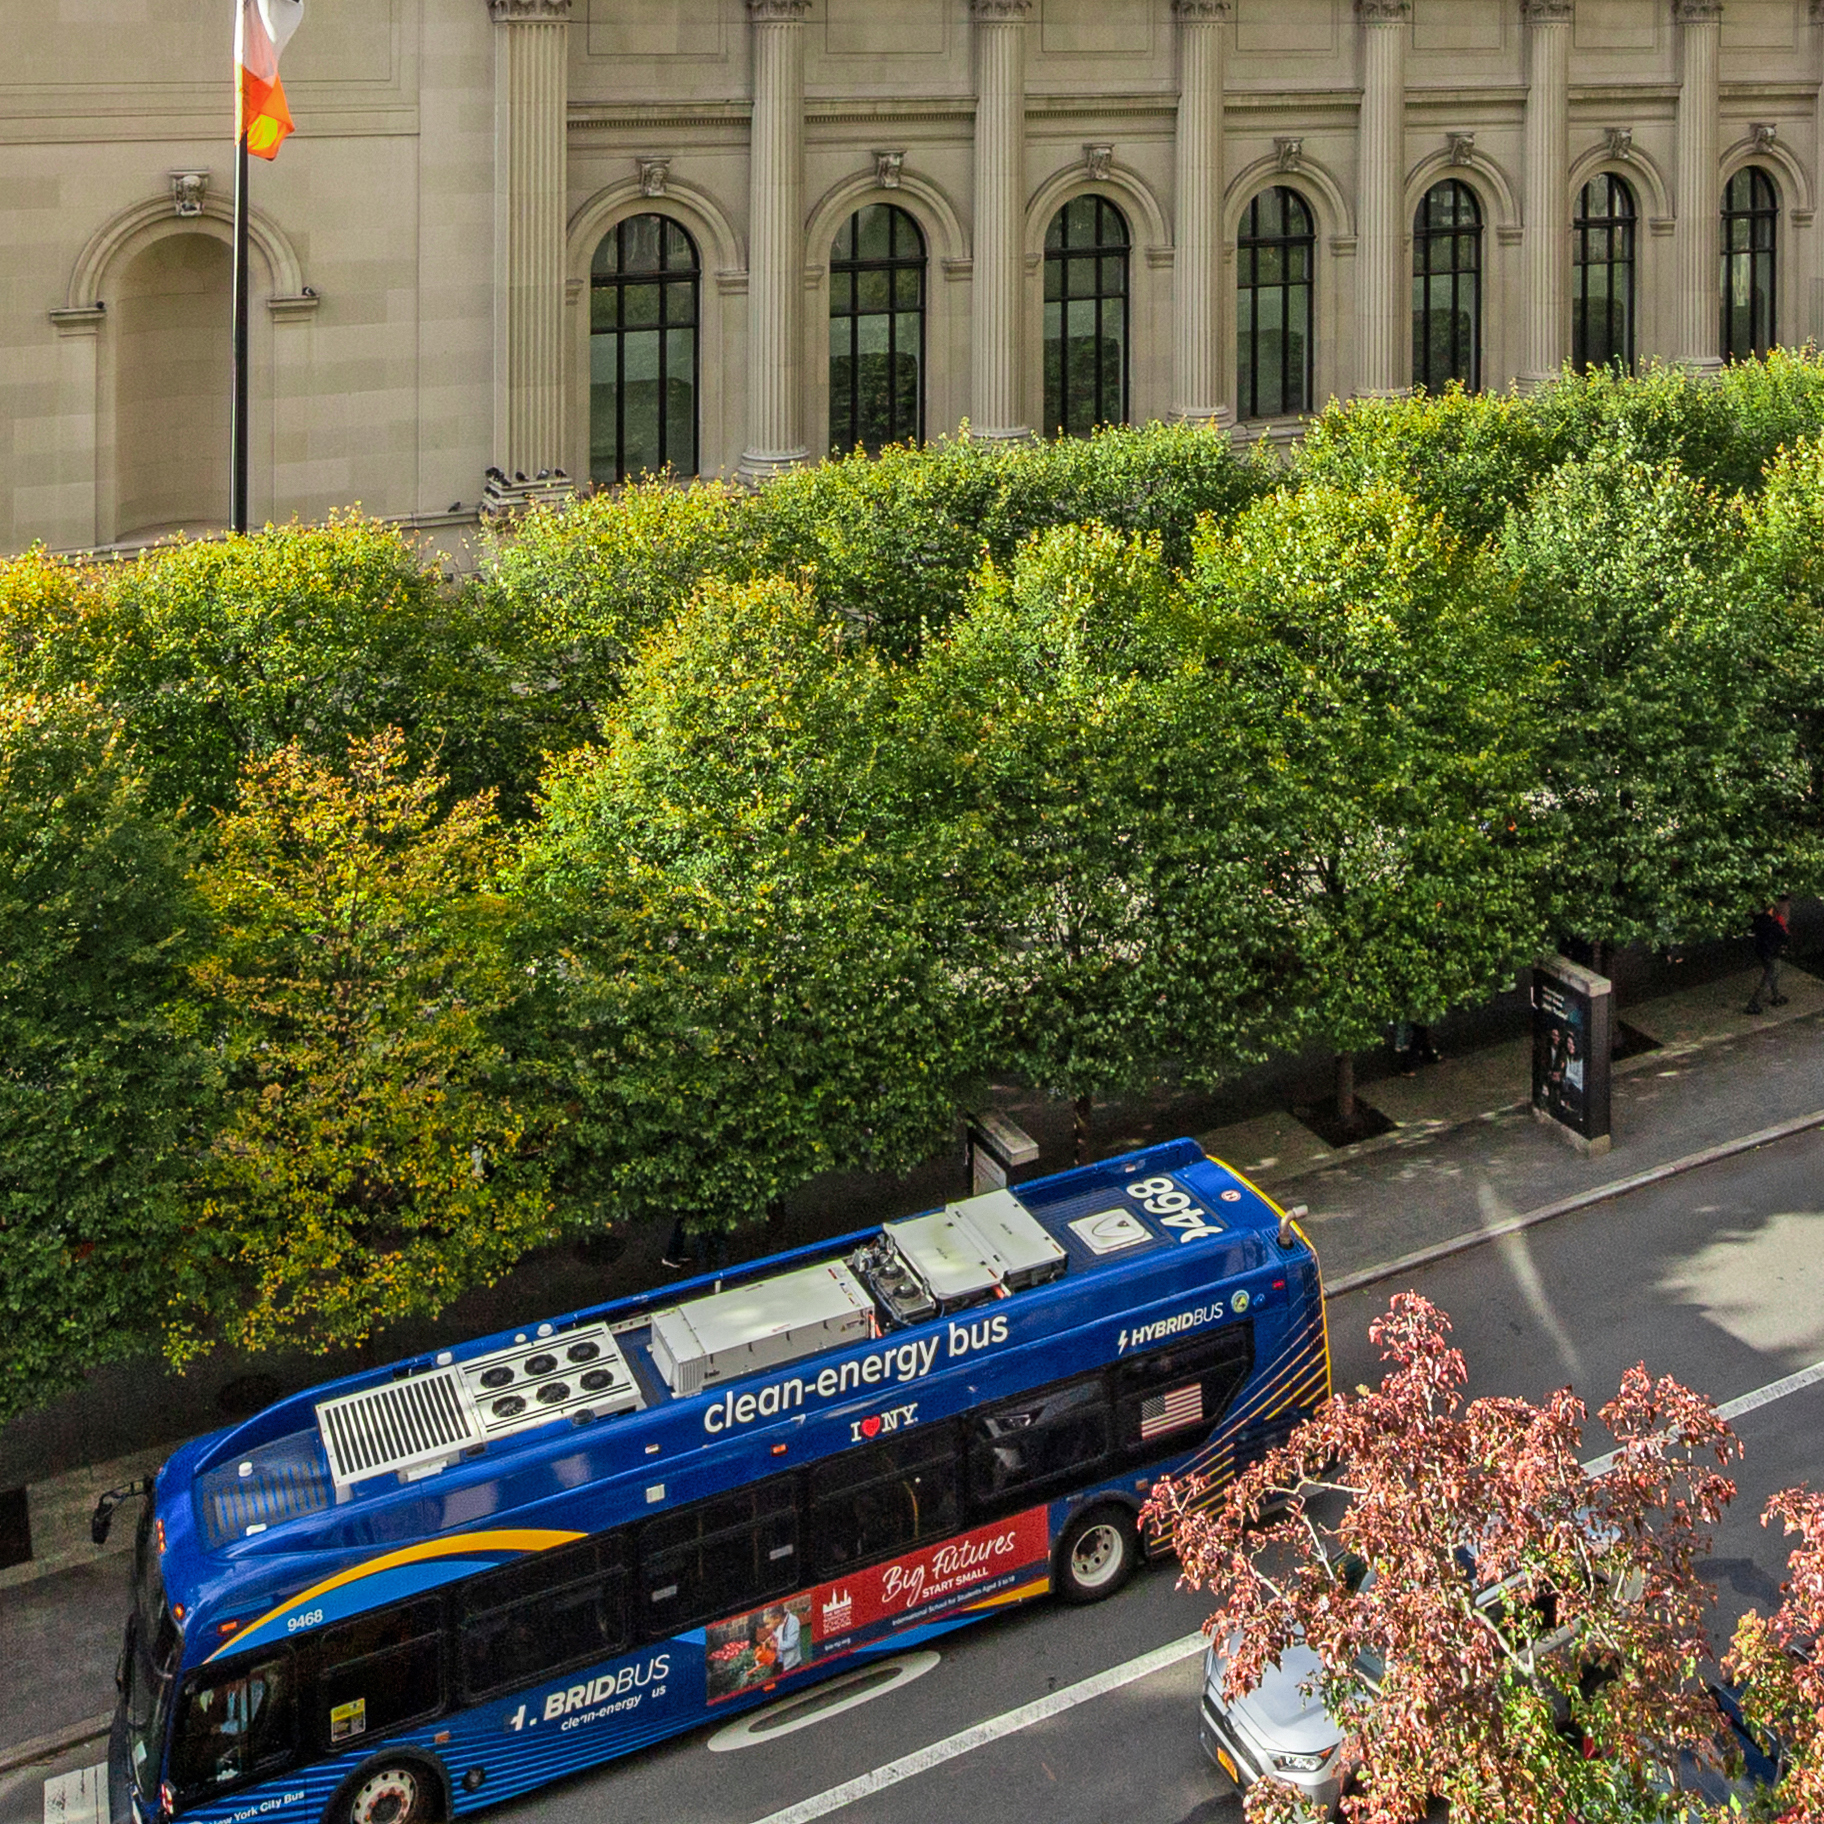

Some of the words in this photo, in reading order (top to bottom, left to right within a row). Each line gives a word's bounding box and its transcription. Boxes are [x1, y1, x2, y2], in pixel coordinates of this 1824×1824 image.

[1131, 1301, 1224, 1346] HYBRIDBUS
[703, 1335, 940, 1434] clean-energy
[948, 1315, 1009, 1357] bus
[881, 1564, 925, 1608] Big
[931, 1531, 1016, 1580] Futures
[922, 1578, 954, 1598] START
[955, 1566, 989, 1586] SMALL
[287, 1608, 324, 1632] 9468
[234, 1806, 258, 1821] York
[259, 1798, 282, 1813] City
[283, 1791, 305, 1804] Bus
